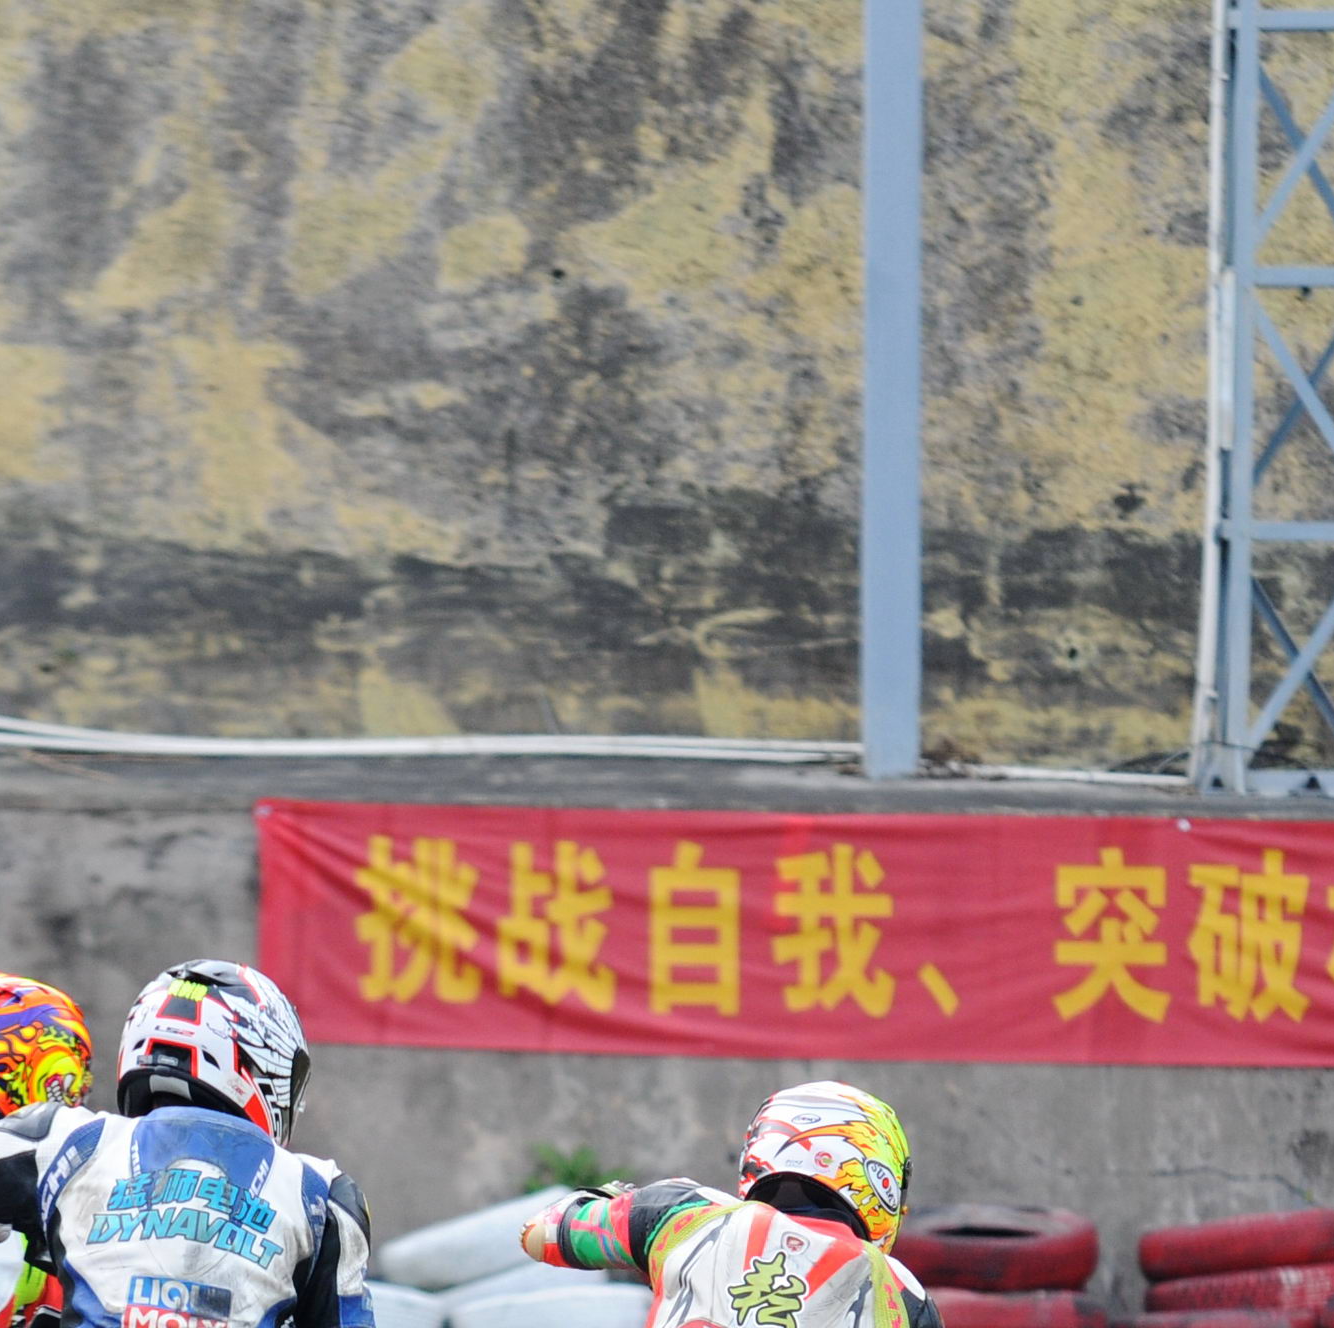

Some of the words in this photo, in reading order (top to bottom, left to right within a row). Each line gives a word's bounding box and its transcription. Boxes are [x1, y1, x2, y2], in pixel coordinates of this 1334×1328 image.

[107, 1168, 277, 1234] 猛狮电池
[87, 1207, 283, 1270] DYNAVOLT
